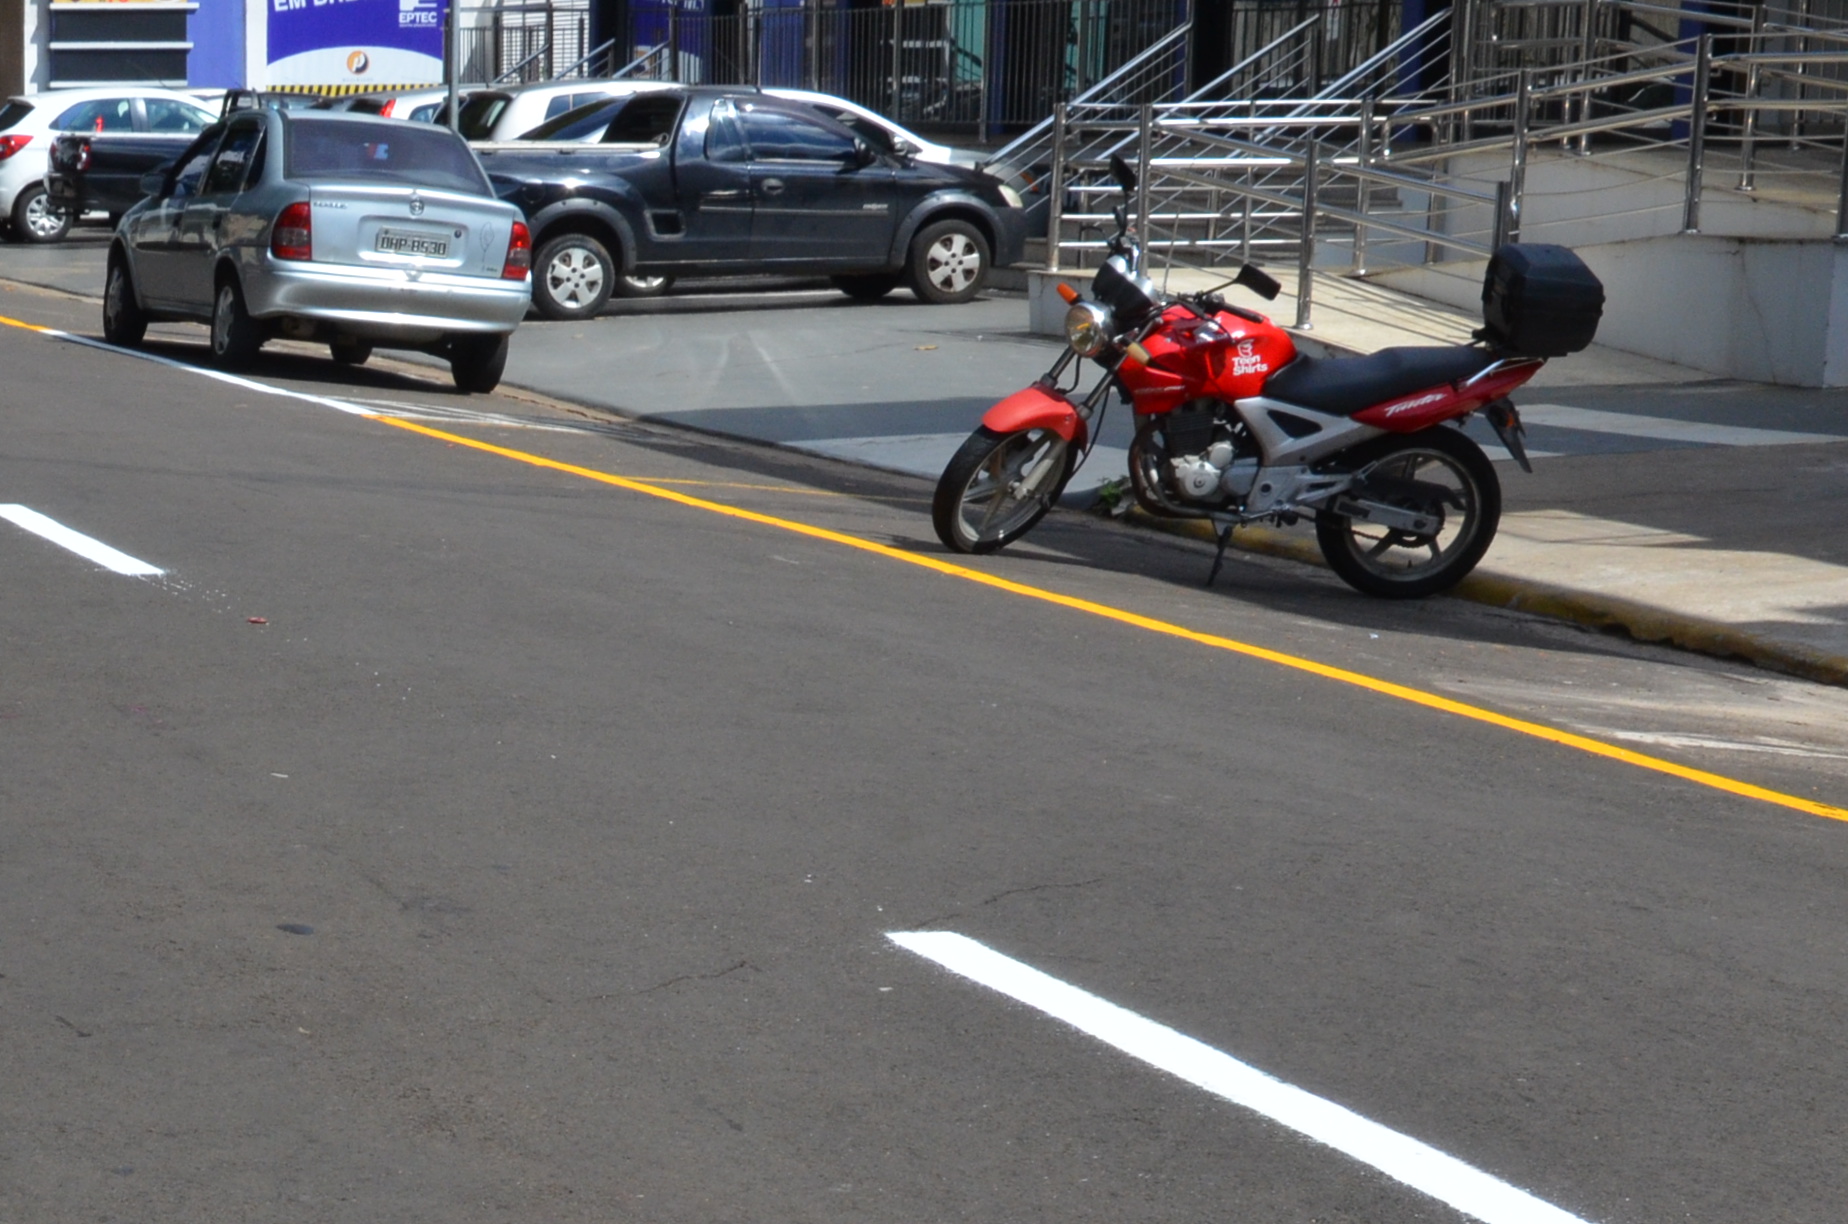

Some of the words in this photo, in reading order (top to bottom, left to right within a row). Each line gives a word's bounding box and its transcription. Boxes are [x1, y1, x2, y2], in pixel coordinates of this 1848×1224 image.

[399, 12, 438, 23] EPTEC
[1232, 354, 1261, 367] Teen
[1232, 363, 1268, 376] Shirts
